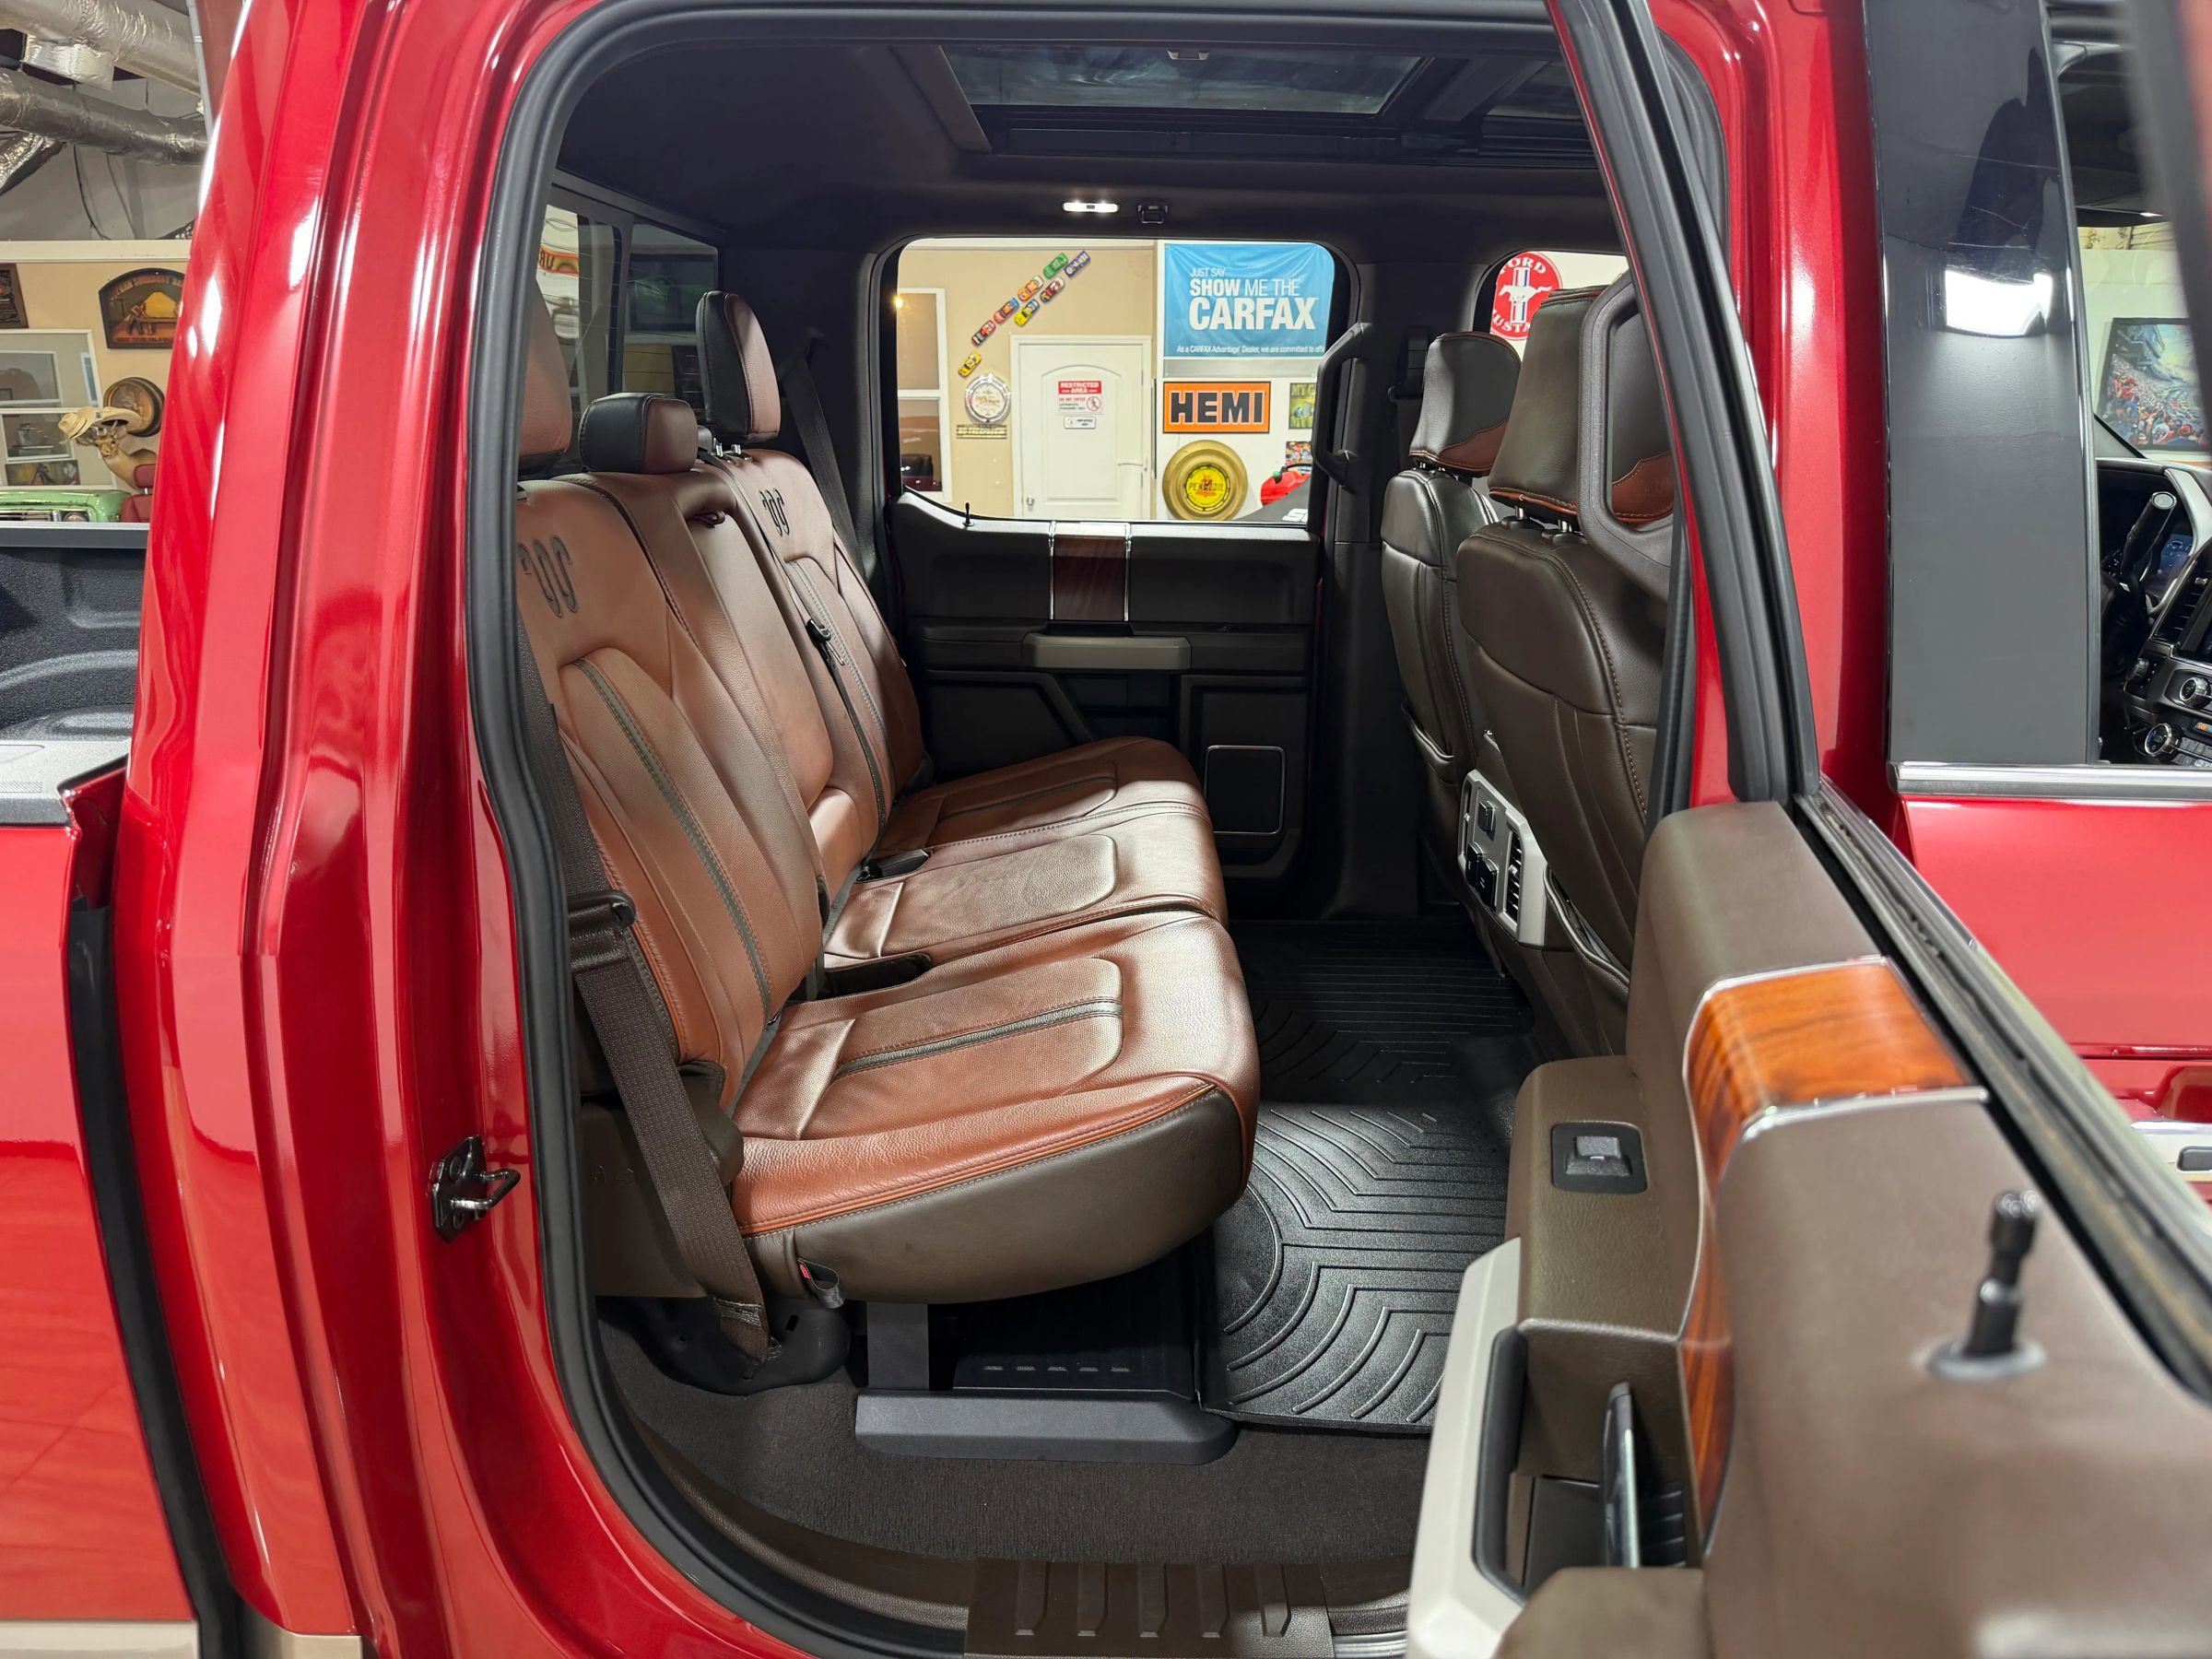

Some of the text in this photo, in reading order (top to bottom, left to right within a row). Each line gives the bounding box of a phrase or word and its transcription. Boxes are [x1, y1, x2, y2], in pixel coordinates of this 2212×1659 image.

[1191, 267, 1226, 277] JUST SAY
[1190, 279, 1300, 297] SHOW ME THE
[1189, 298, 1316, 331] CARFAX
[1493, 309, 1531, 333] USTA
[1170, 391, 1265, 425] HEMI
